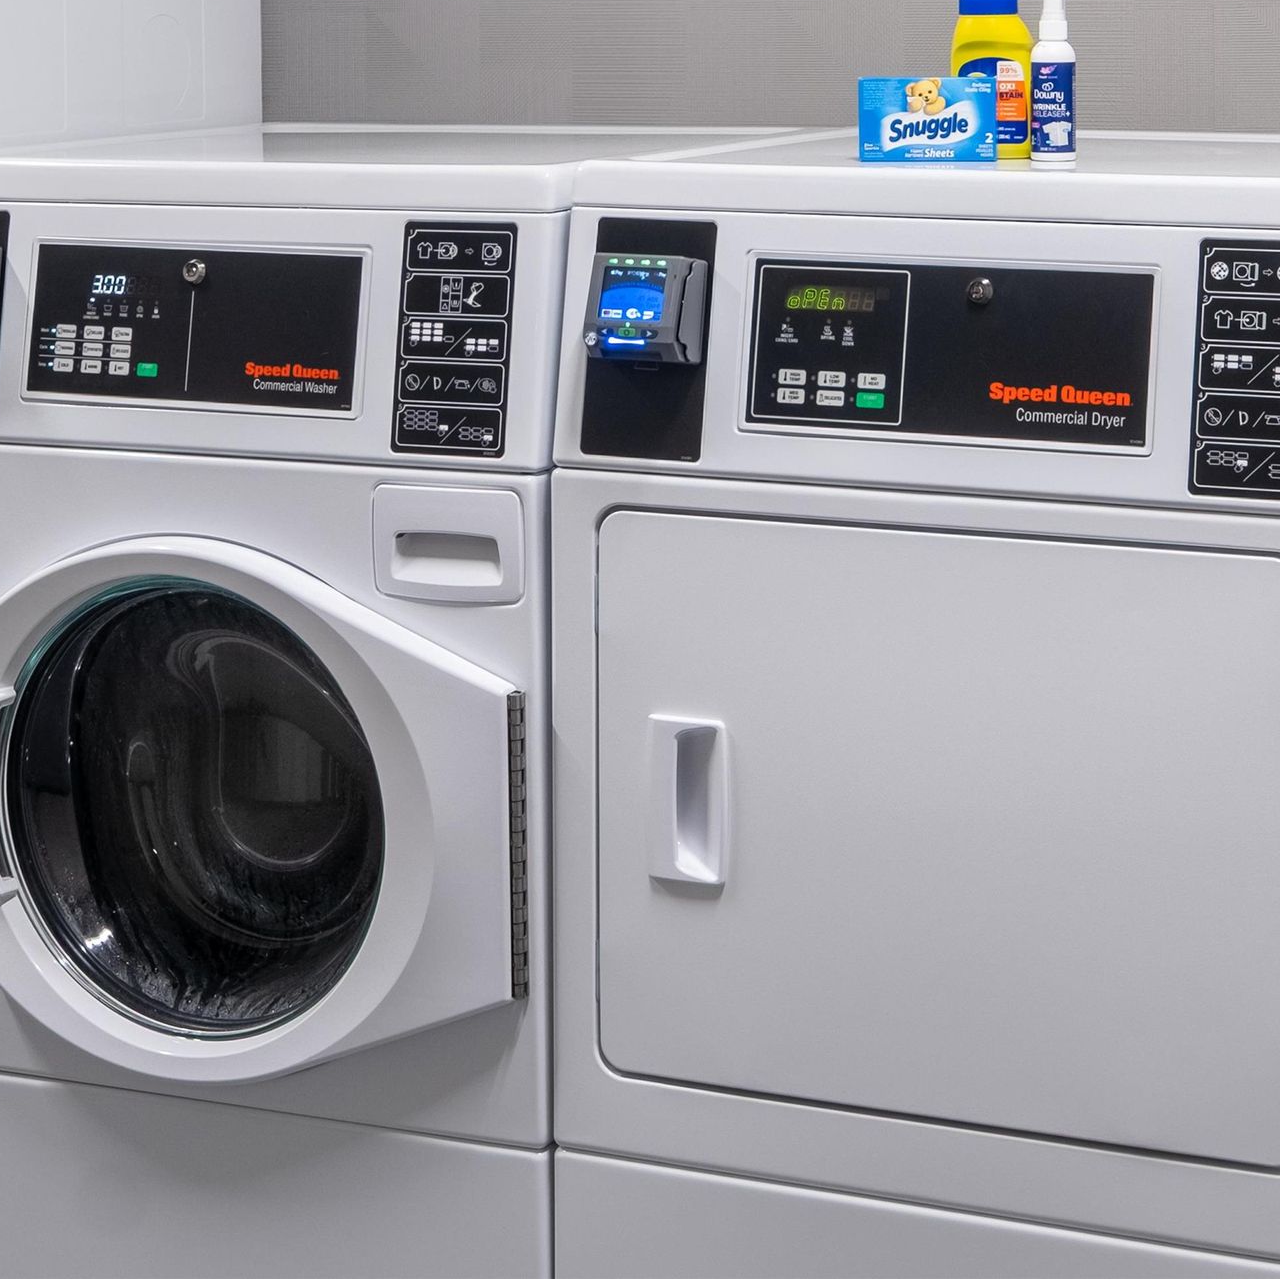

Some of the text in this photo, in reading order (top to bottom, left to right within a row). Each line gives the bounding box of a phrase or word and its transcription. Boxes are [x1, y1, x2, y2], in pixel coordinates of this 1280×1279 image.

[1034, 89, 1064, 102] Downy
[1032, 103, 1066, 111] WRINKLE
[889, 112, 969, 142] Snuggle
[985, 132, 993, 143] 2
[924, 148, 955, 158] Sheets
[91, 274, 127, 295] 3.00
[245, 361, 339, 379] Speed Queen
[253, 379, 337, 394] Commercial Washer
[989, 382, 1131, 406] Speed Queen
[1016, 407, 1126, 429] Commercial Dryer
